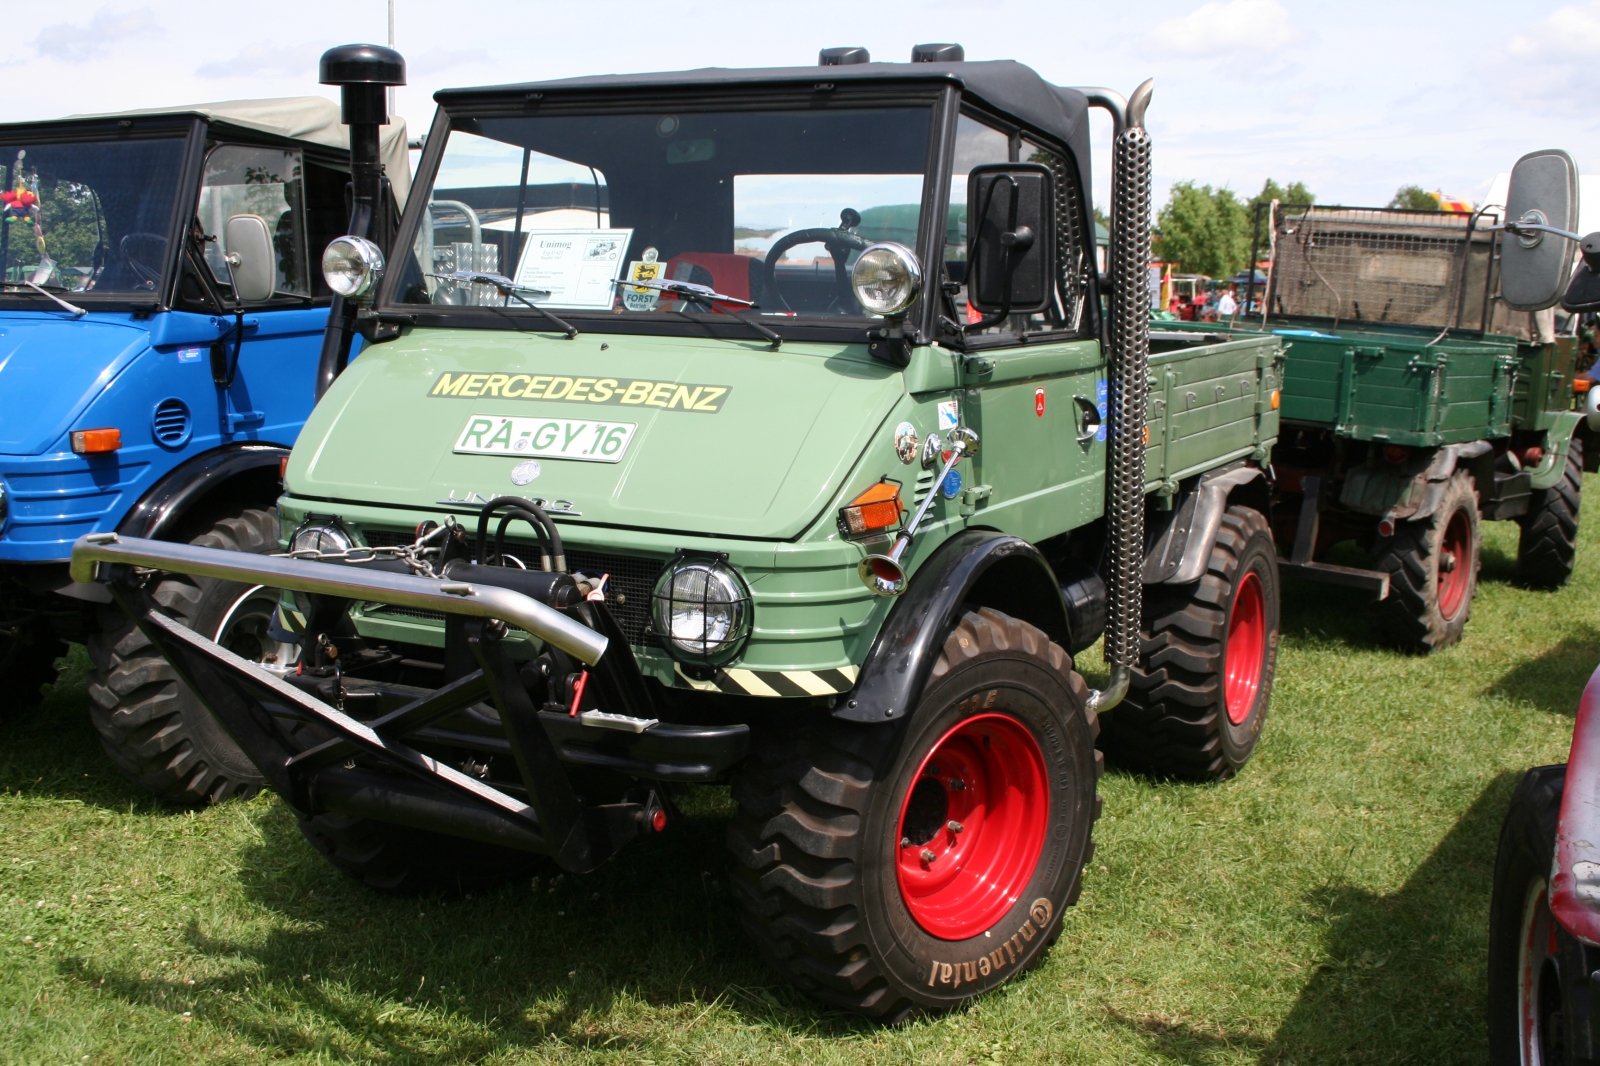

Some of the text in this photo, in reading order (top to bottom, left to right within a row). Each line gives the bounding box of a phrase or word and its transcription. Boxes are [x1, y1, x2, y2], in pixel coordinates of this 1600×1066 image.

[540, 240, 573, 250] Unimog
[627, 294, 654, 302] FORST
[432, 373, 727, 411] MERCEDES-BENZ
[461, 419, 627, 455] RA-GY 16
[928, 898, 1053, 989] Continental
